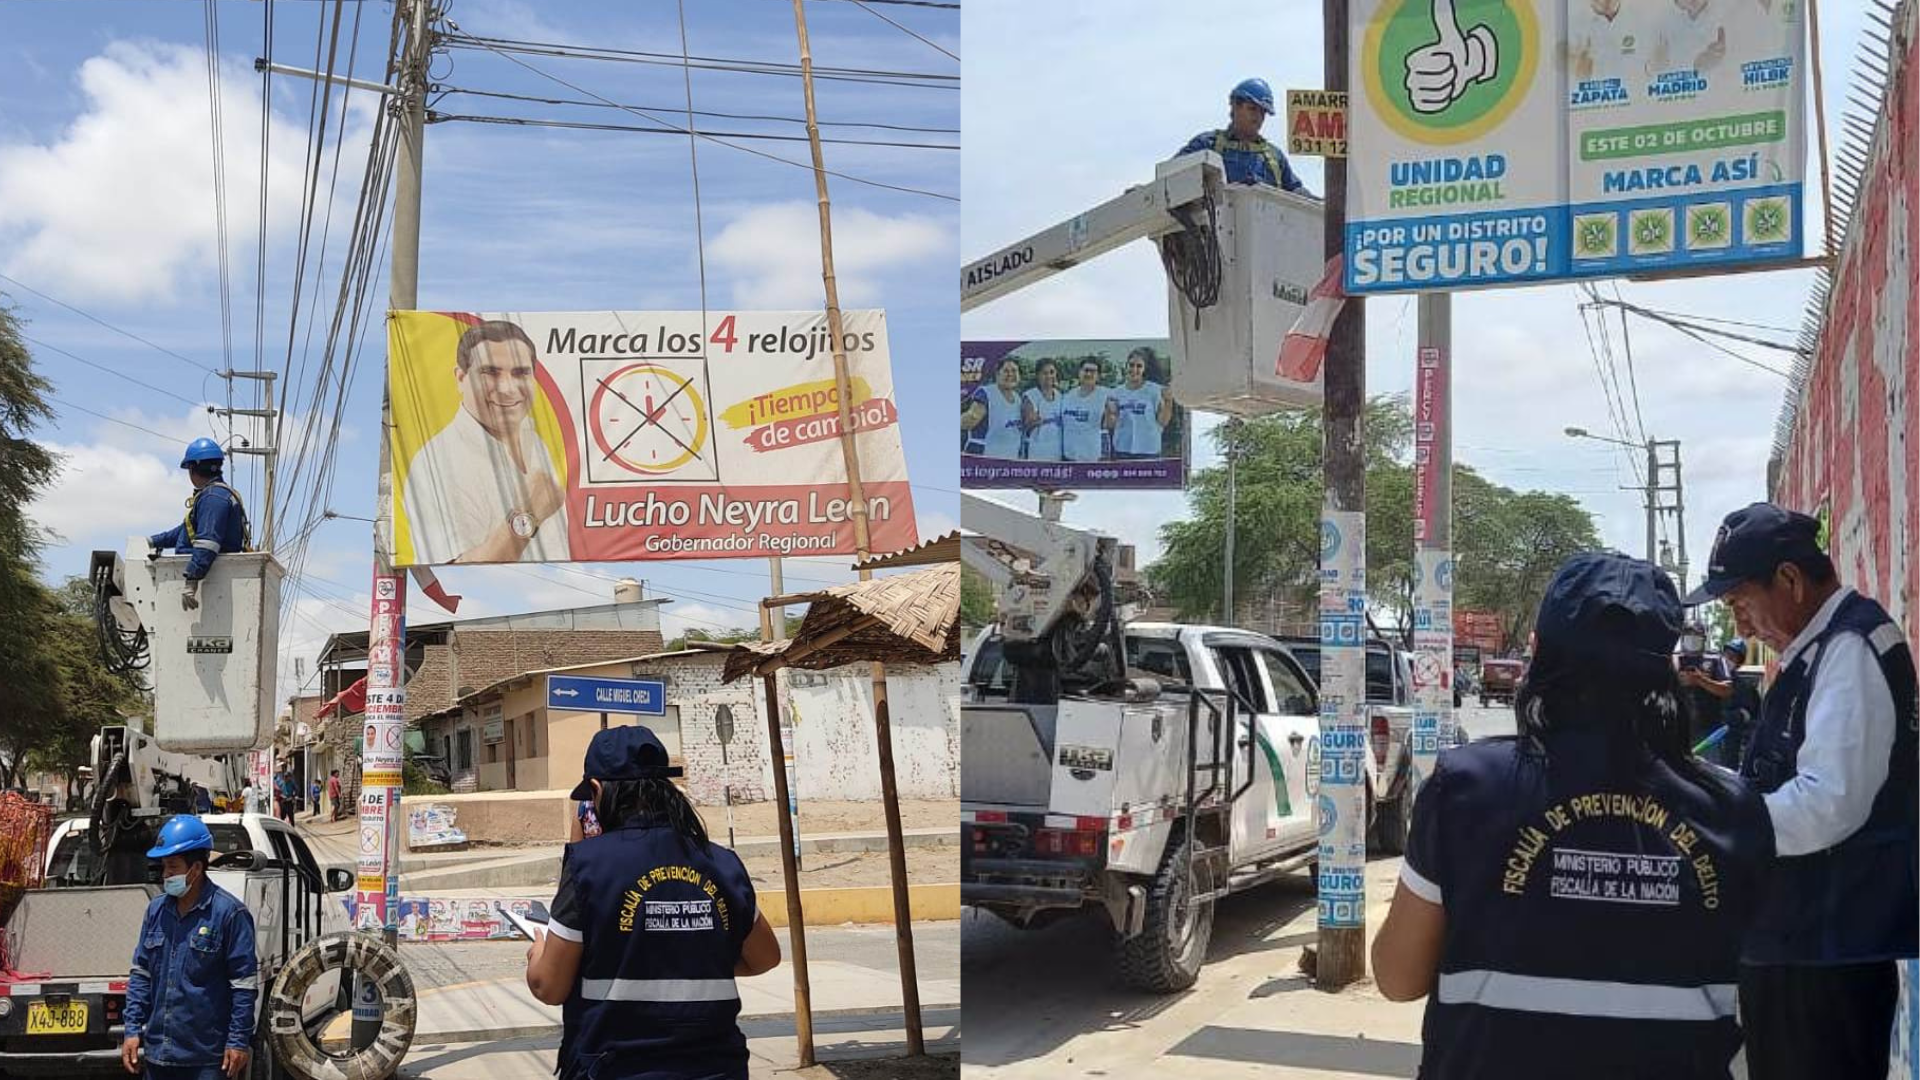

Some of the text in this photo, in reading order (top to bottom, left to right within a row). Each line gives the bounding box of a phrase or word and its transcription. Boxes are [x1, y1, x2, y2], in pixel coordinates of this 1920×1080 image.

[1572, 89, 1628, 104] ZAPATA
[1648, 79, 1707, 96] MADRID
[1292, 110, 1347, 139] AM
[1587, 119, 1777, 152] ESTE 02 DE OCTUBRE
[1293, 140, 1322, 153] 931
[1391, 155, 1506, 186] UNIDAD
[1603, 152, 1759, 193] MARCA ASÍ
[1390, 181, 1506, 208] REGIONAL
[1355, 215, 1546, 249] ¡POR UN DISTRITO
[967, 247, 1034, 289] AISLADO
[1354, 237, 1547, 284] SEGURO!
[547, 327, 648, 354] Marca
[657, 326, 701, 353] los
[709, 315, 738, 353] 4
[760, 420, 791, 447] de
[975, 464, 1038, 480] logramos
[584, 495, 691, 528] Lucho
[699, 493, 799, 533] Neyra
[645, 531, 837, 553] Gobernador Regional
[366, 694, 383, 703] STE
[386, 694, 393, 703] 4
[596, 687, 612, 702] CALLE
[368, 794, 384, 805] DE
[1503, 826, 1550, 895] FISCALÍA
[1544, 805, 1571, 831] DE
[1670, 821, 1698, 854] DEL
[1693, 854, 1720, 909] DELITO
[1553, 854, 1622, 874] MINISTERIO
[1603, 882, 1618, 898] DE
[1620, 882, 1636, 899] LA
[1639, 880, 1680, 901] NACIÓN
[619, 890, 643, 932] FISCALÍA
[636, 875, 652, 892] DE
[702, 879, 719, 900] DEL
[645, 903, 681, 915] MINISTERIO
[671, 917, 681, 927] DE
[681, 917, 690, 927] LA
[361, 981, 378, 1003] 3
